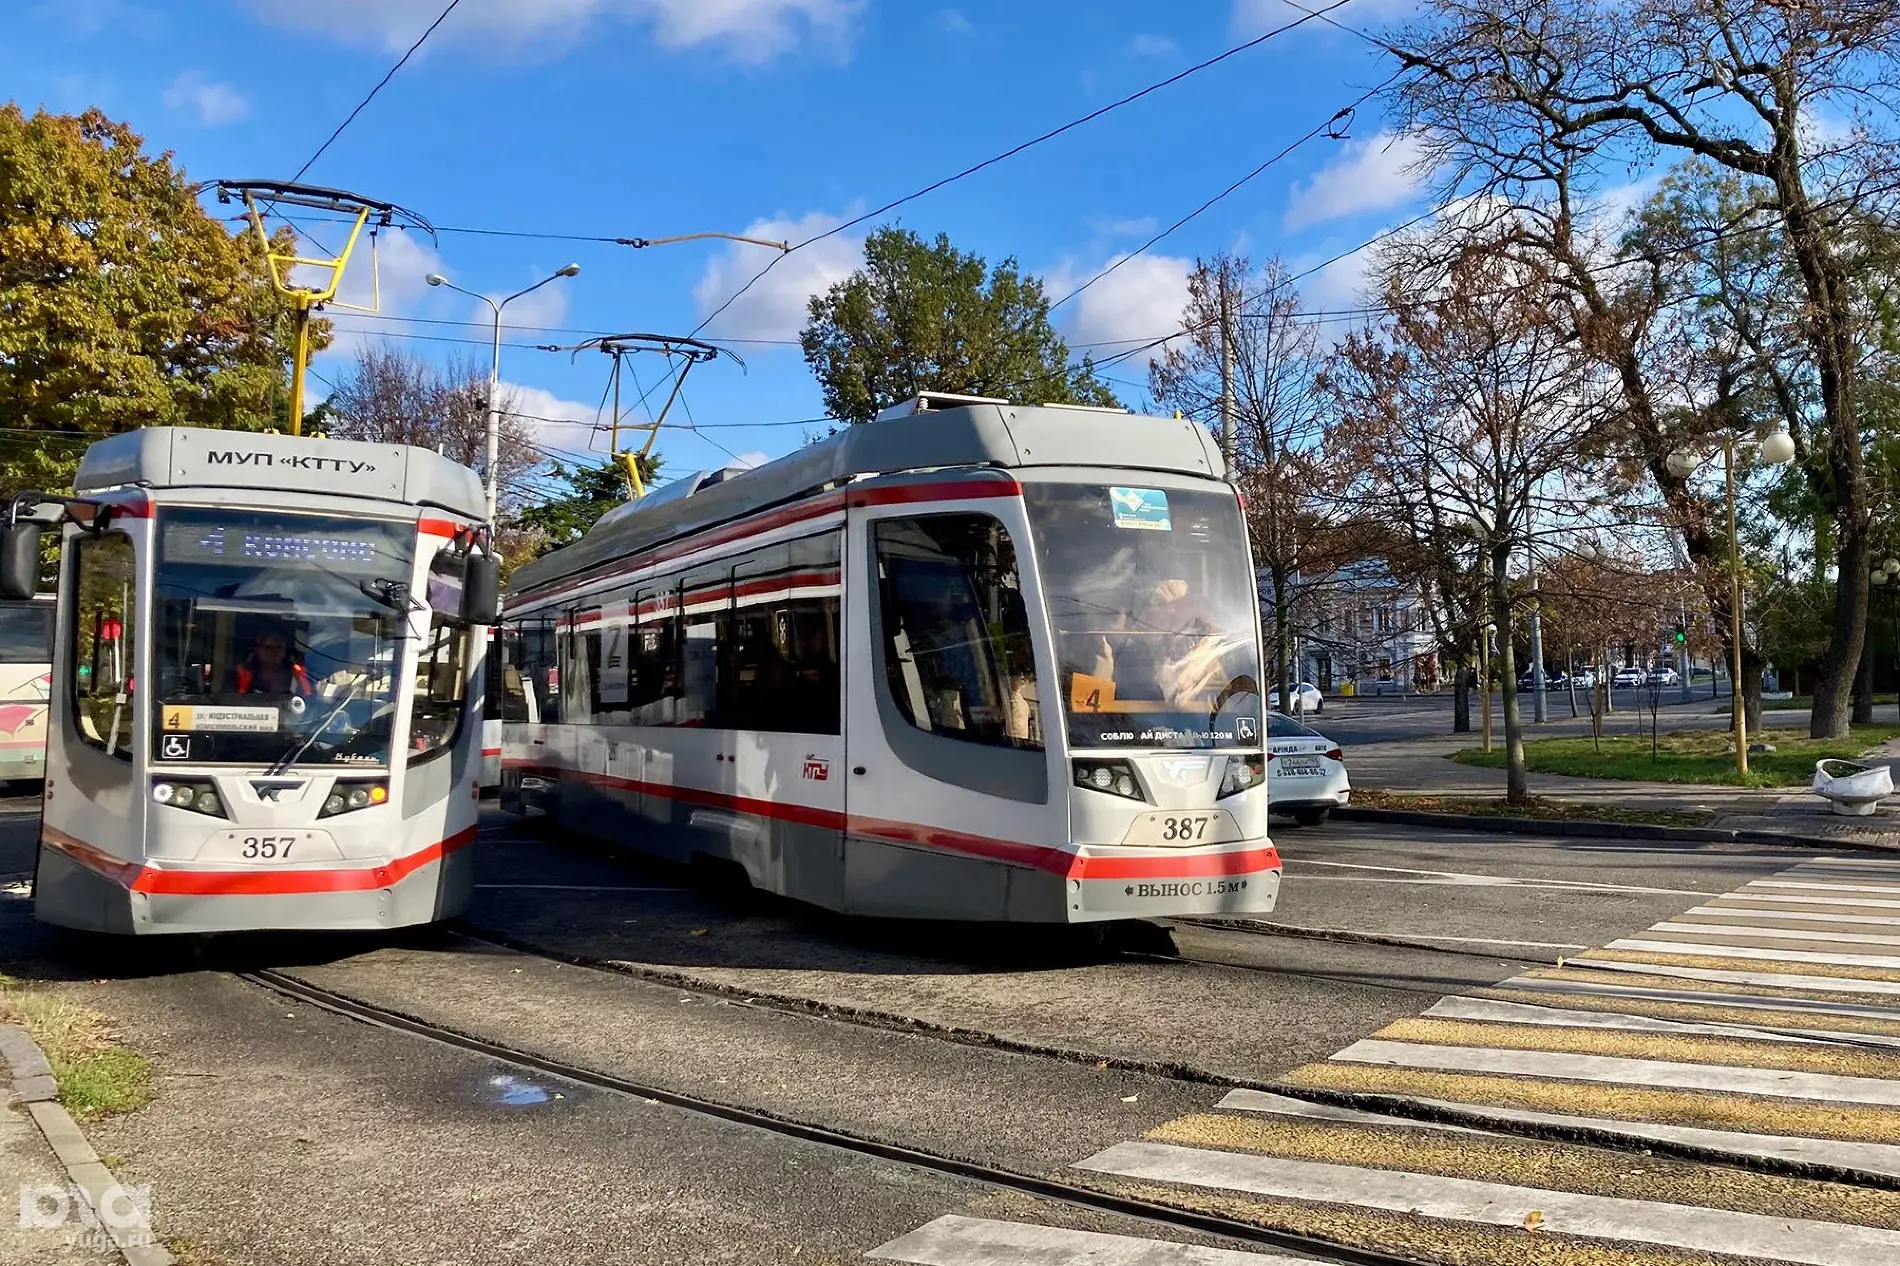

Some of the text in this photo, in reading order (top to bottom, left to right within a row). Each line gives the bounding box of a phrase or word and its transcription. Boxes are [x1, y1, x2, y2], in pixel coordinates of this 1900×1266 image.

[207, 451, 376, 473] МУП «КТТУ»
[1086, 687, 1101, 712] 4
[168, 712, 181, 729] 4
[1210, 731, 1225, 740] 120
[1162, 817, 1208, 841] 387
[242, 836, 296, 858] 357
[1137, 882, 1203, 897] ВЫНОС
[1206, 881, 1226, 894] 1.5
